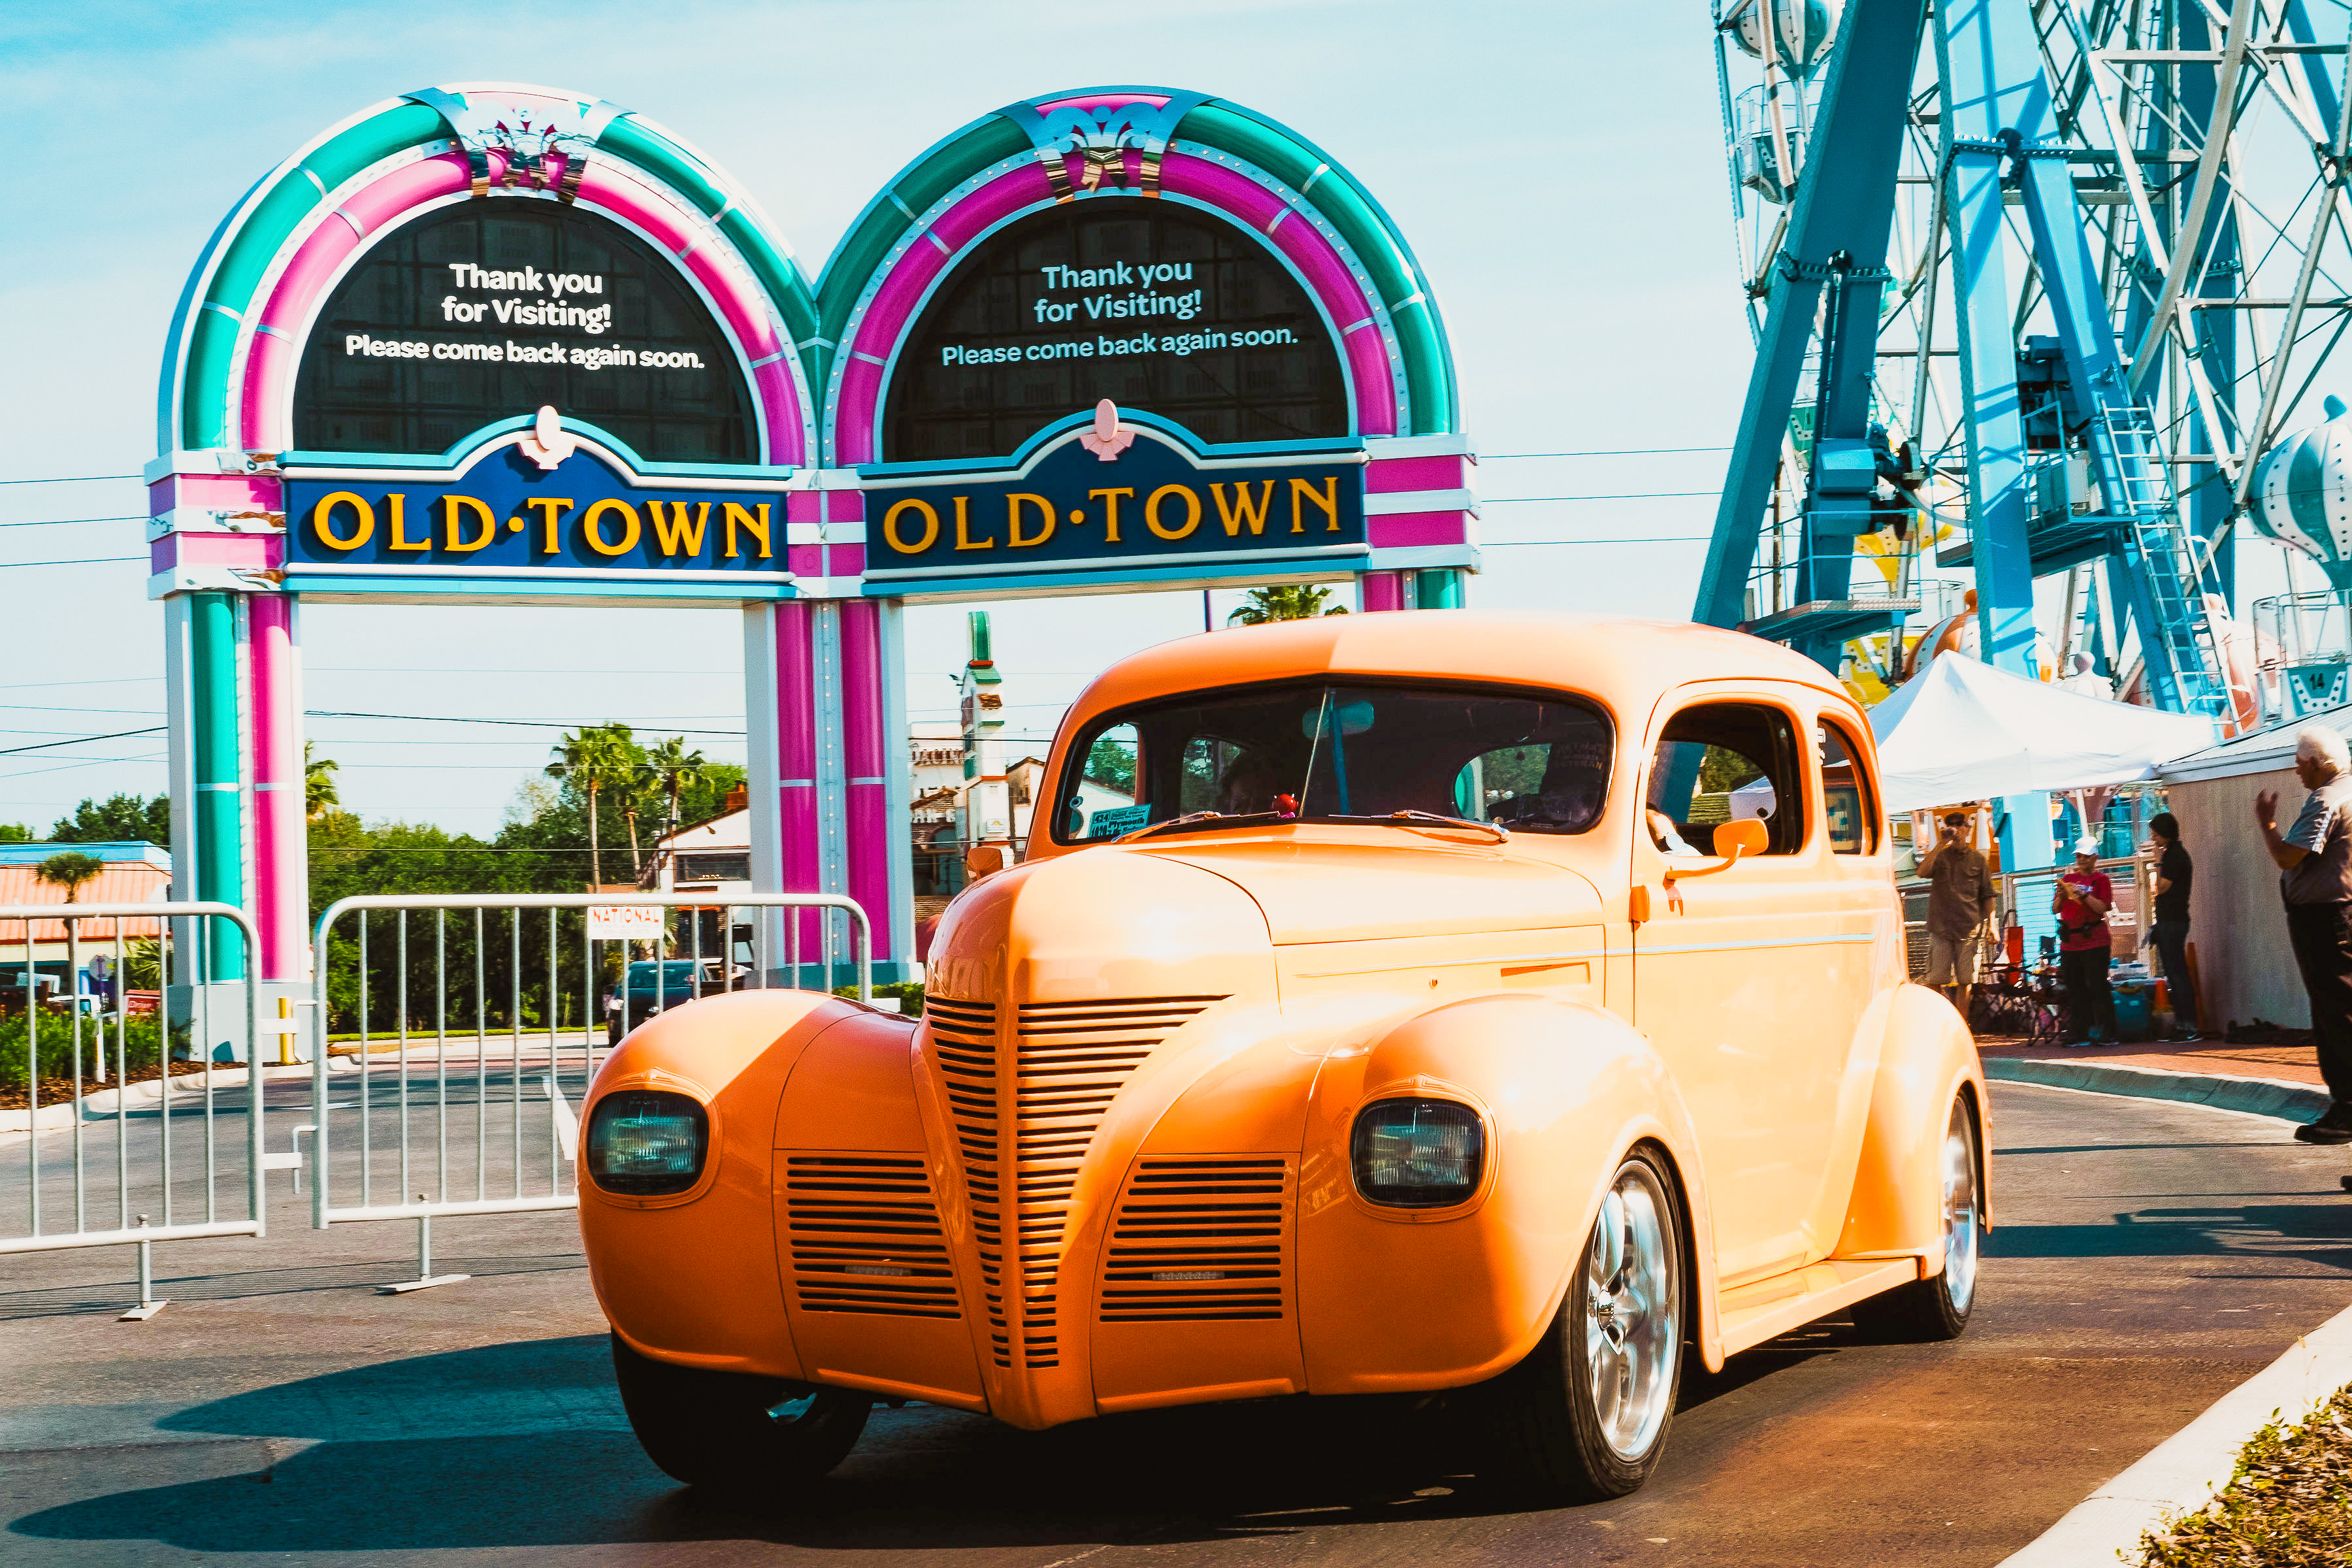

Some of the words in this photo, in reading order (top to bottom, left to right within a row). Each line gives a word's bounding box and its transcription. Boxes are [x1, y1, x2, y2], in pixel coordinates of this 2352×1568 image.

[449, 263, 544, 291] Thank
[547, 273, 603, 299] you
[1040, 261, 1134, 289] Thank
[1137, 262, 1193, 289] you
[440, 295, 489, 323] for
[491, 297, 612, 335] Visiting!
[1033, 298, 1079, 323] for
[1083, 289, 1202, 320] Visiting!
[346, 334, 430, 359] Please
[432, 342, 504, 362] come
[506, 340, 568, 364] back
[570, 344, 637, 370] again
[639, 350, 705, 369] soon.
[942, 343, 1022, 366] Please
[1025, 342, 1094, 361] come
[1098, 332, 1158, 356] back
[1161, 328, 1227, 356] again
[1230, 328, 1298, 347] soon.
[314, 491, 497, 552] OLD
[527, 497, 774, 559] TOWN
[884, 493, 1056, 553] OLD
[1088, 476, 1341, 542] TOWN
[2310, 673, 2325, 690] 14
[1109, 817, 1145, 829] Plymouth
[593, 908, 659, 923] NATIONAL
